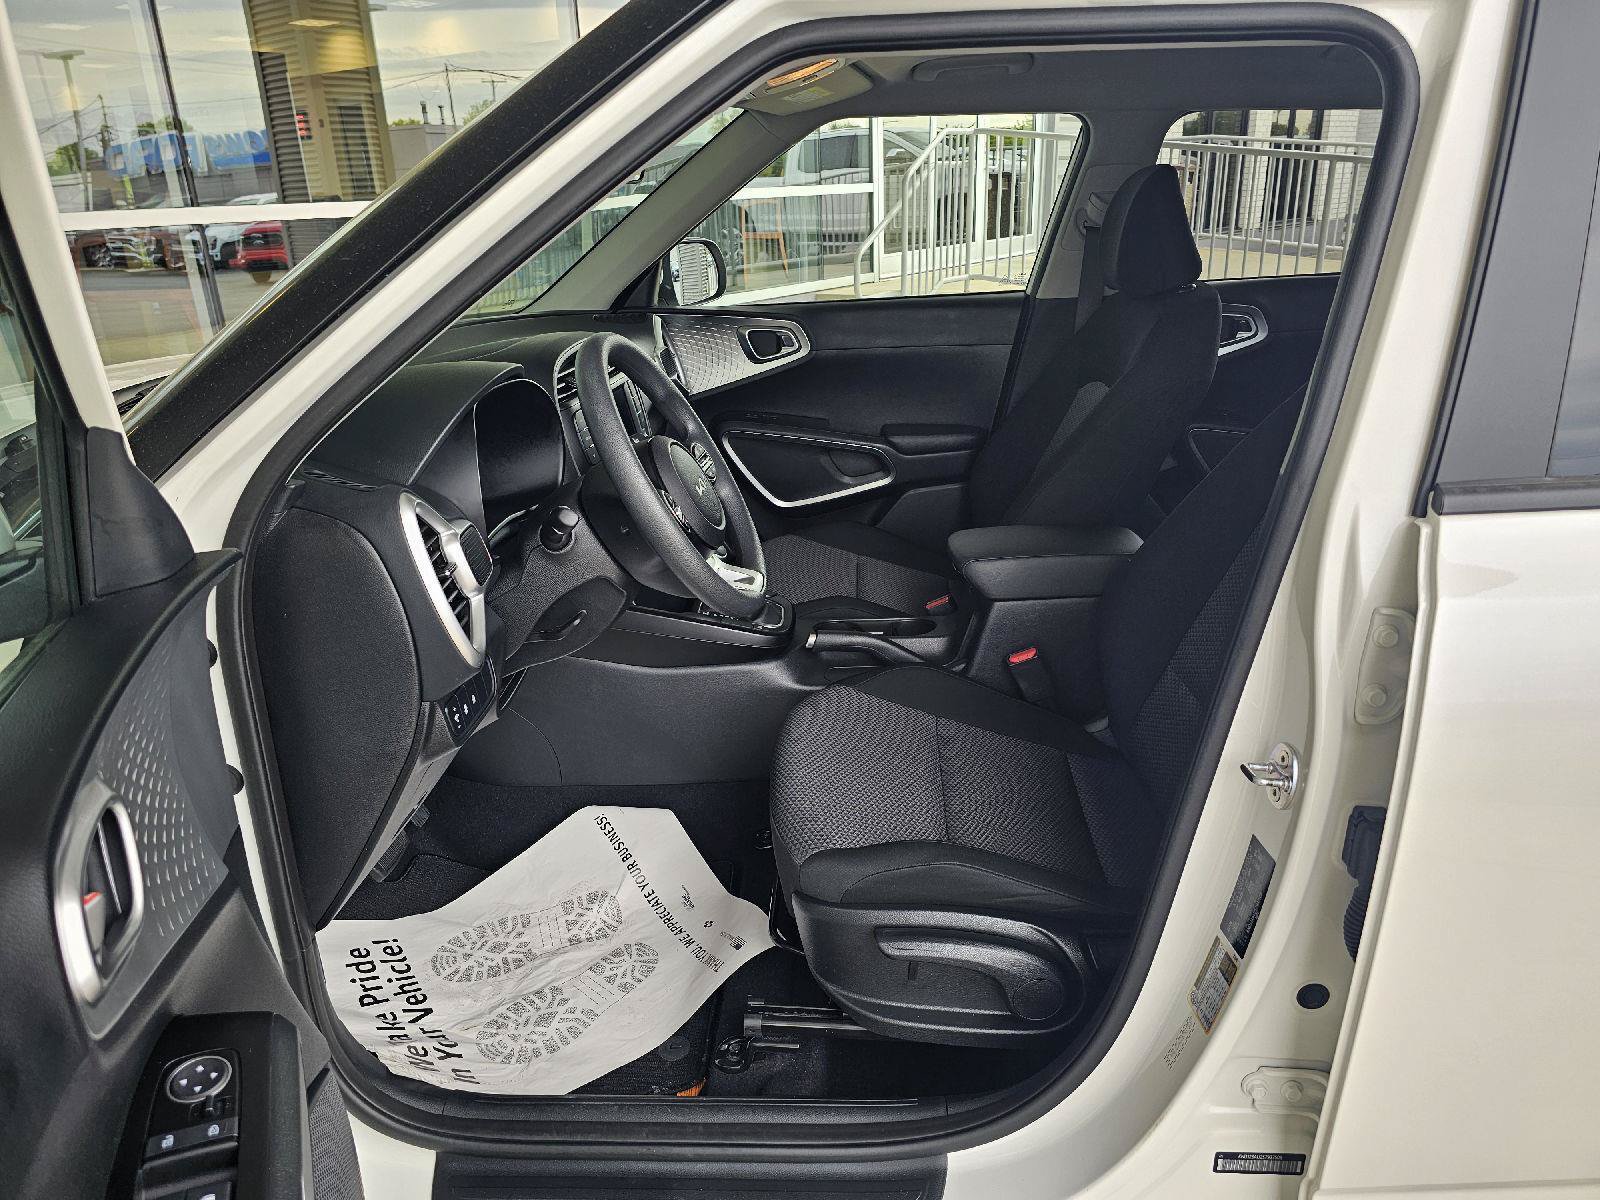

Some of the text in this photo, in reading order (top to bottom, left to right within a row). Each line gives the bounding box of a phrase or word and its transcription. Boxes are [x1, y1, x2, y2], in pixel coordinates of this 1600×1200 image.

[594, 813, 633, 863] BUSINESS!
[626, 859, 650, 890] YOUR
[643, 888, 685, 937] APPRECIATE
[678, 933, 696, 949] WE
[345, 947, 390, 1007] Pride
[372, 938, 434, 1024] Vehicle!
[374, 1011, 412, 1044] ake
[419, 1026, 463, 1061] Your
